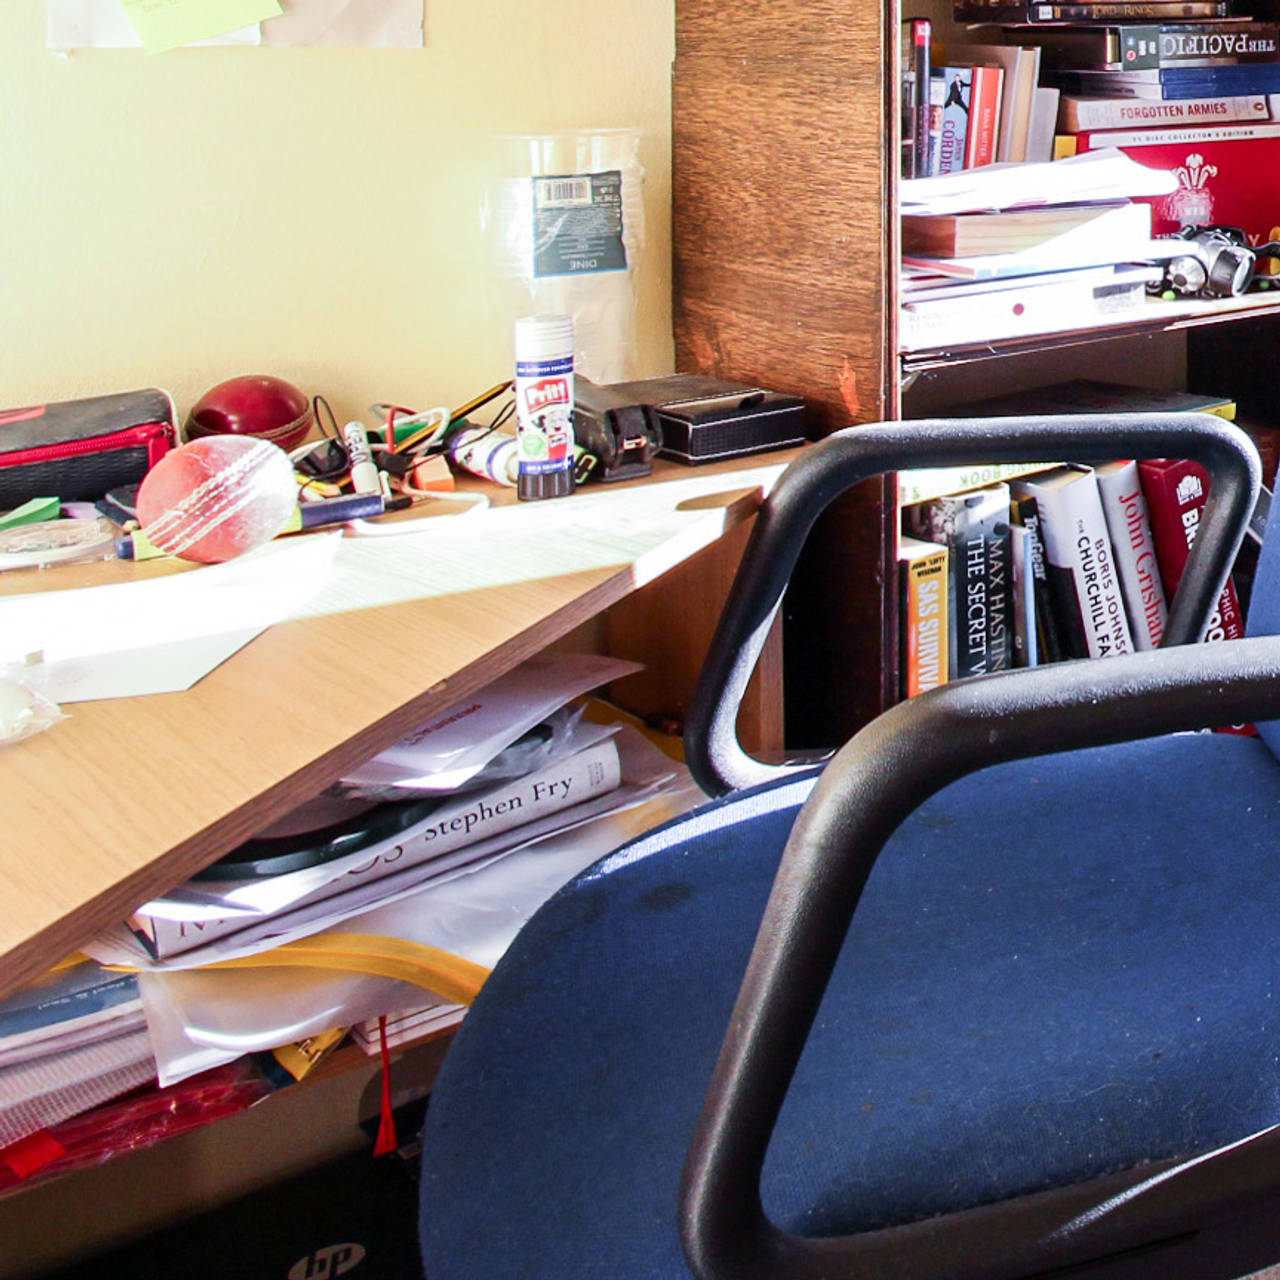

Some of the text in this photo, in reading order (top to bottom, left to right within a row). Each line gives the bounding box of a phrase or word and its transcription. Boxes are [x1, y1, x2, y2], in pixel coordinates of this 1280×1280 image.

[1163, 33, 1249, 56] PACIFIC
[1250, 39, 1277, 53] THE
[1120, 102, 1228, 119] FORGOTTEN ARMIES
[1222, 129, 1255, 138] EDITION
[940, 120, 956, 175] CORDEN
[569, 259, 598, 272] DINE
[526, 380, 567, 406] Pritt
[959, 464, 1001, 487] BOOK
[1118, 490, 1146, 552] John
[967, 533, 986, 579] THE
[1094, 538, 1114, 591] BORIS
[989, 538, 1008, 673] MAX HASTIN
[1077, 535, 1107, 633] CHURCHILL
[917, 578, 941, 693] SAS SURVIVA
[967, 581, 987, 656] SECRET
[424, 775, 575, 843] Stephen Fry
[302, 1242, 355, 1280] hp
